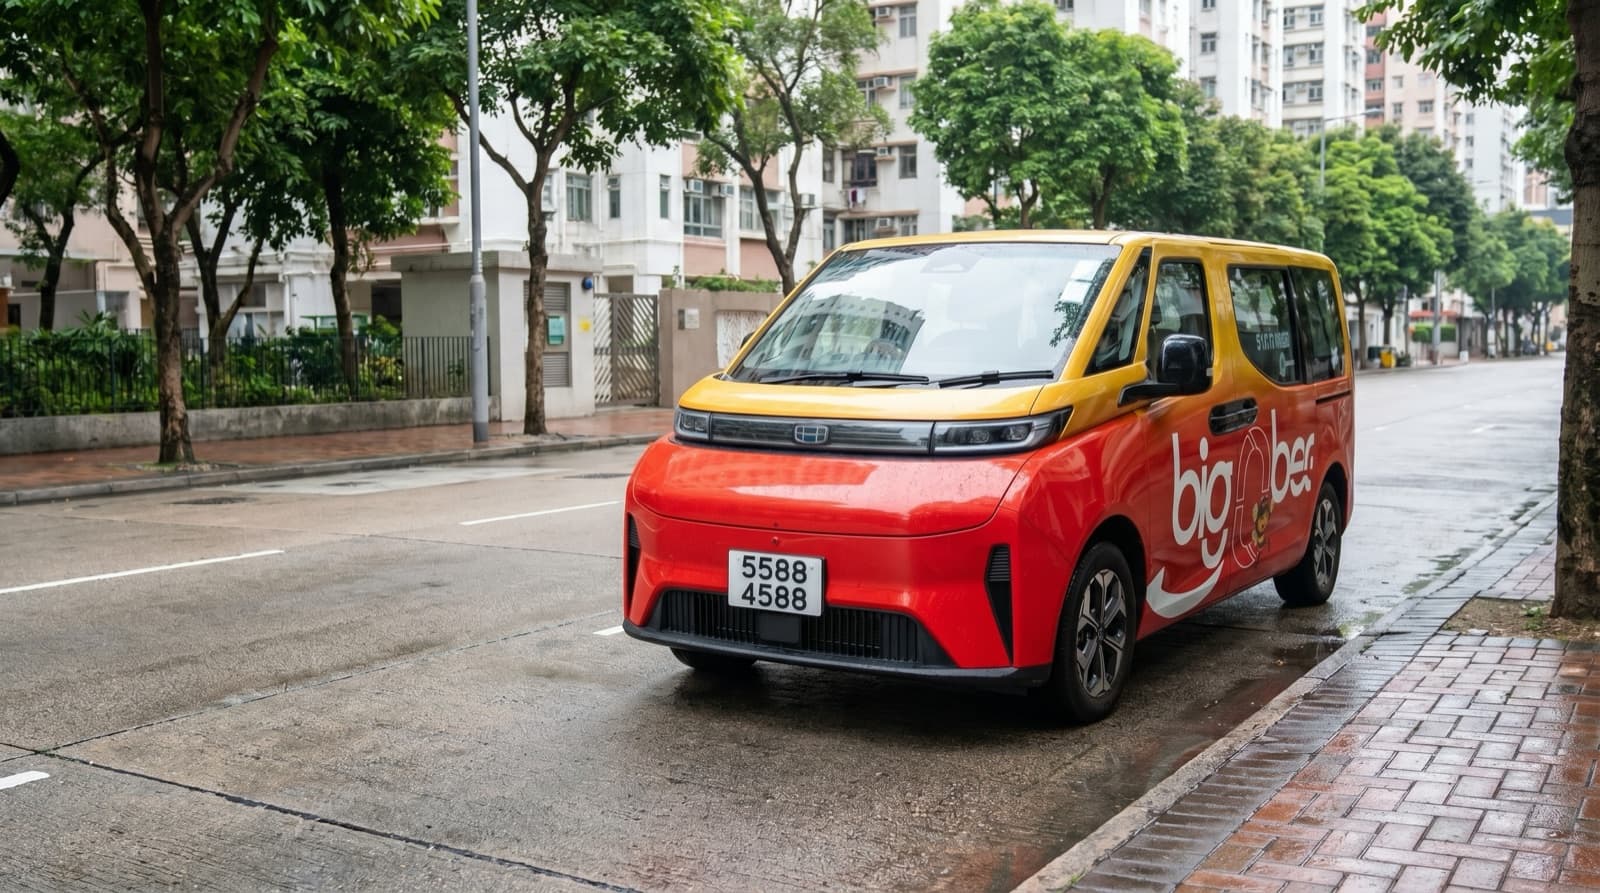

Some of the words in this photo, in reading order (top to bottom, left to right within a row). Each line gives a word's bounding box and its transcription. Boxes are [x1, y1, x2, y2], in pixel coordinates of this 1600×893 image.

[1172, 432, 1233, 569] big
[742, 555, 807, 584] 5588
[741, 582, 807, 611] 4588
